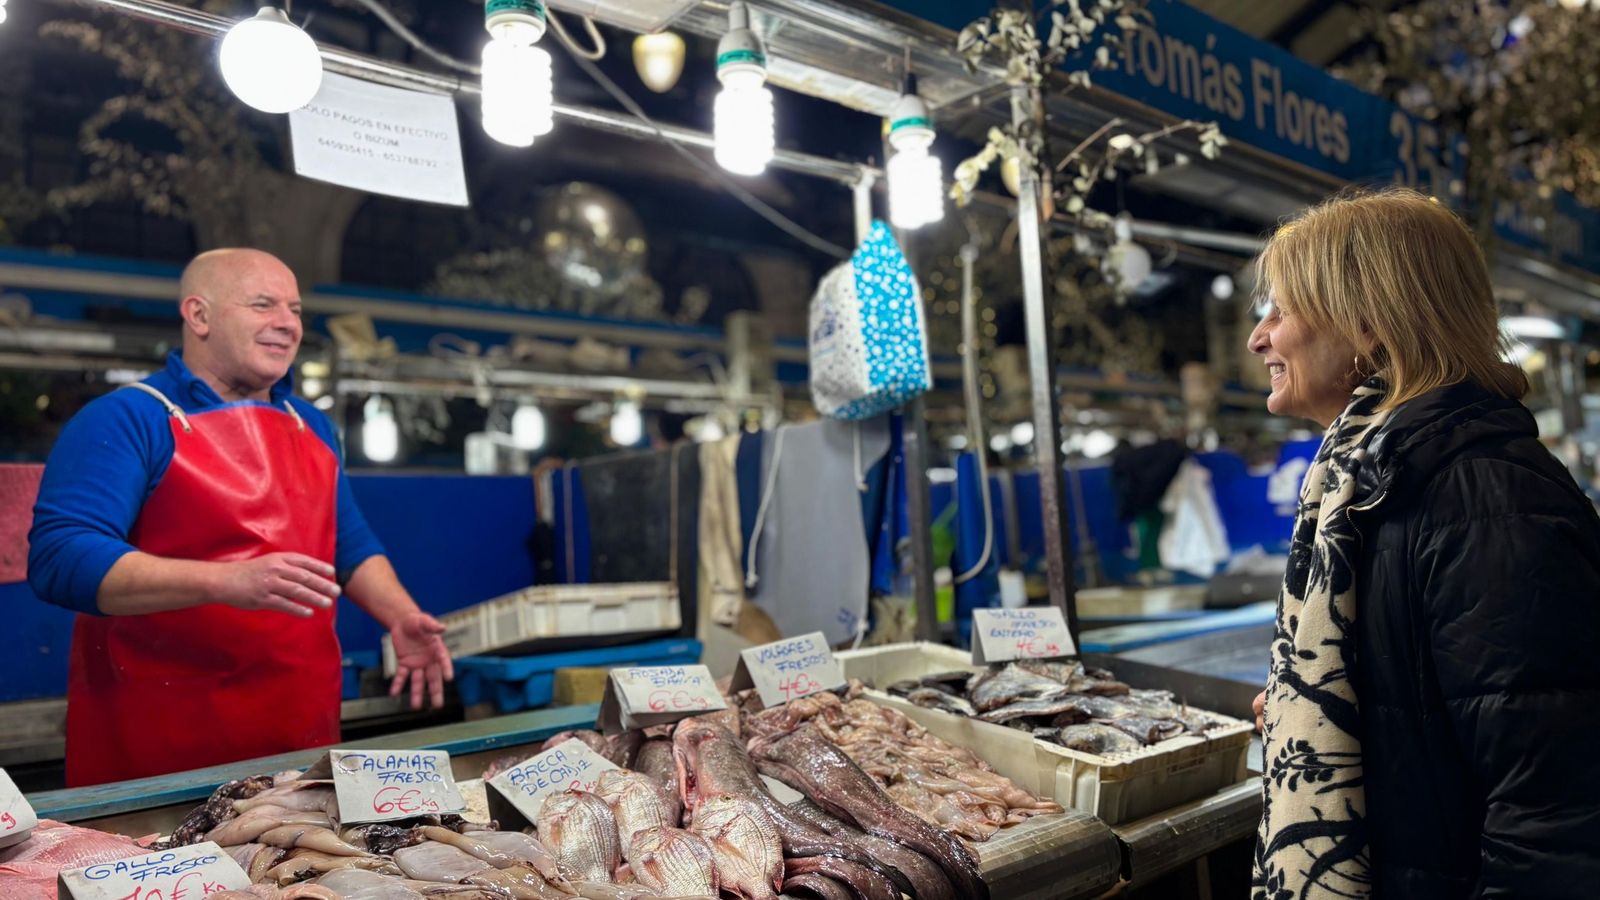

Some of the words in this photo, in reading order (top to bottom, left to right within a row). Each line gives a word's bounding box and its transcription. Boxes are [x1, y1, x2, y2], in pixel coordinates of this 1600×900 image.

[1251, 57, 1350, 164] Flores
[333, 111, 373, 129] PAGOS
[376, 121, 392, 133] EN
[394, 125, 449, 142] EFECTIVO
[353, 131, 363, 141] O
[365, 133, 400, 148] BIZUM
[775, 653, 828, 673] FRESCOS
[647, 689, 692, 713] 6€
[778, 673, 811, 703] 4€
[339, 753, 437, 772] CALAMAR
[507, 749, 568, 787] BRECA
[377, 770, 441, 785] FRESCO
[373, 786, 422, 814] 6€
[84, 852, 177, 881] GALLO
[130, 855, 218, 883] FRESCO
